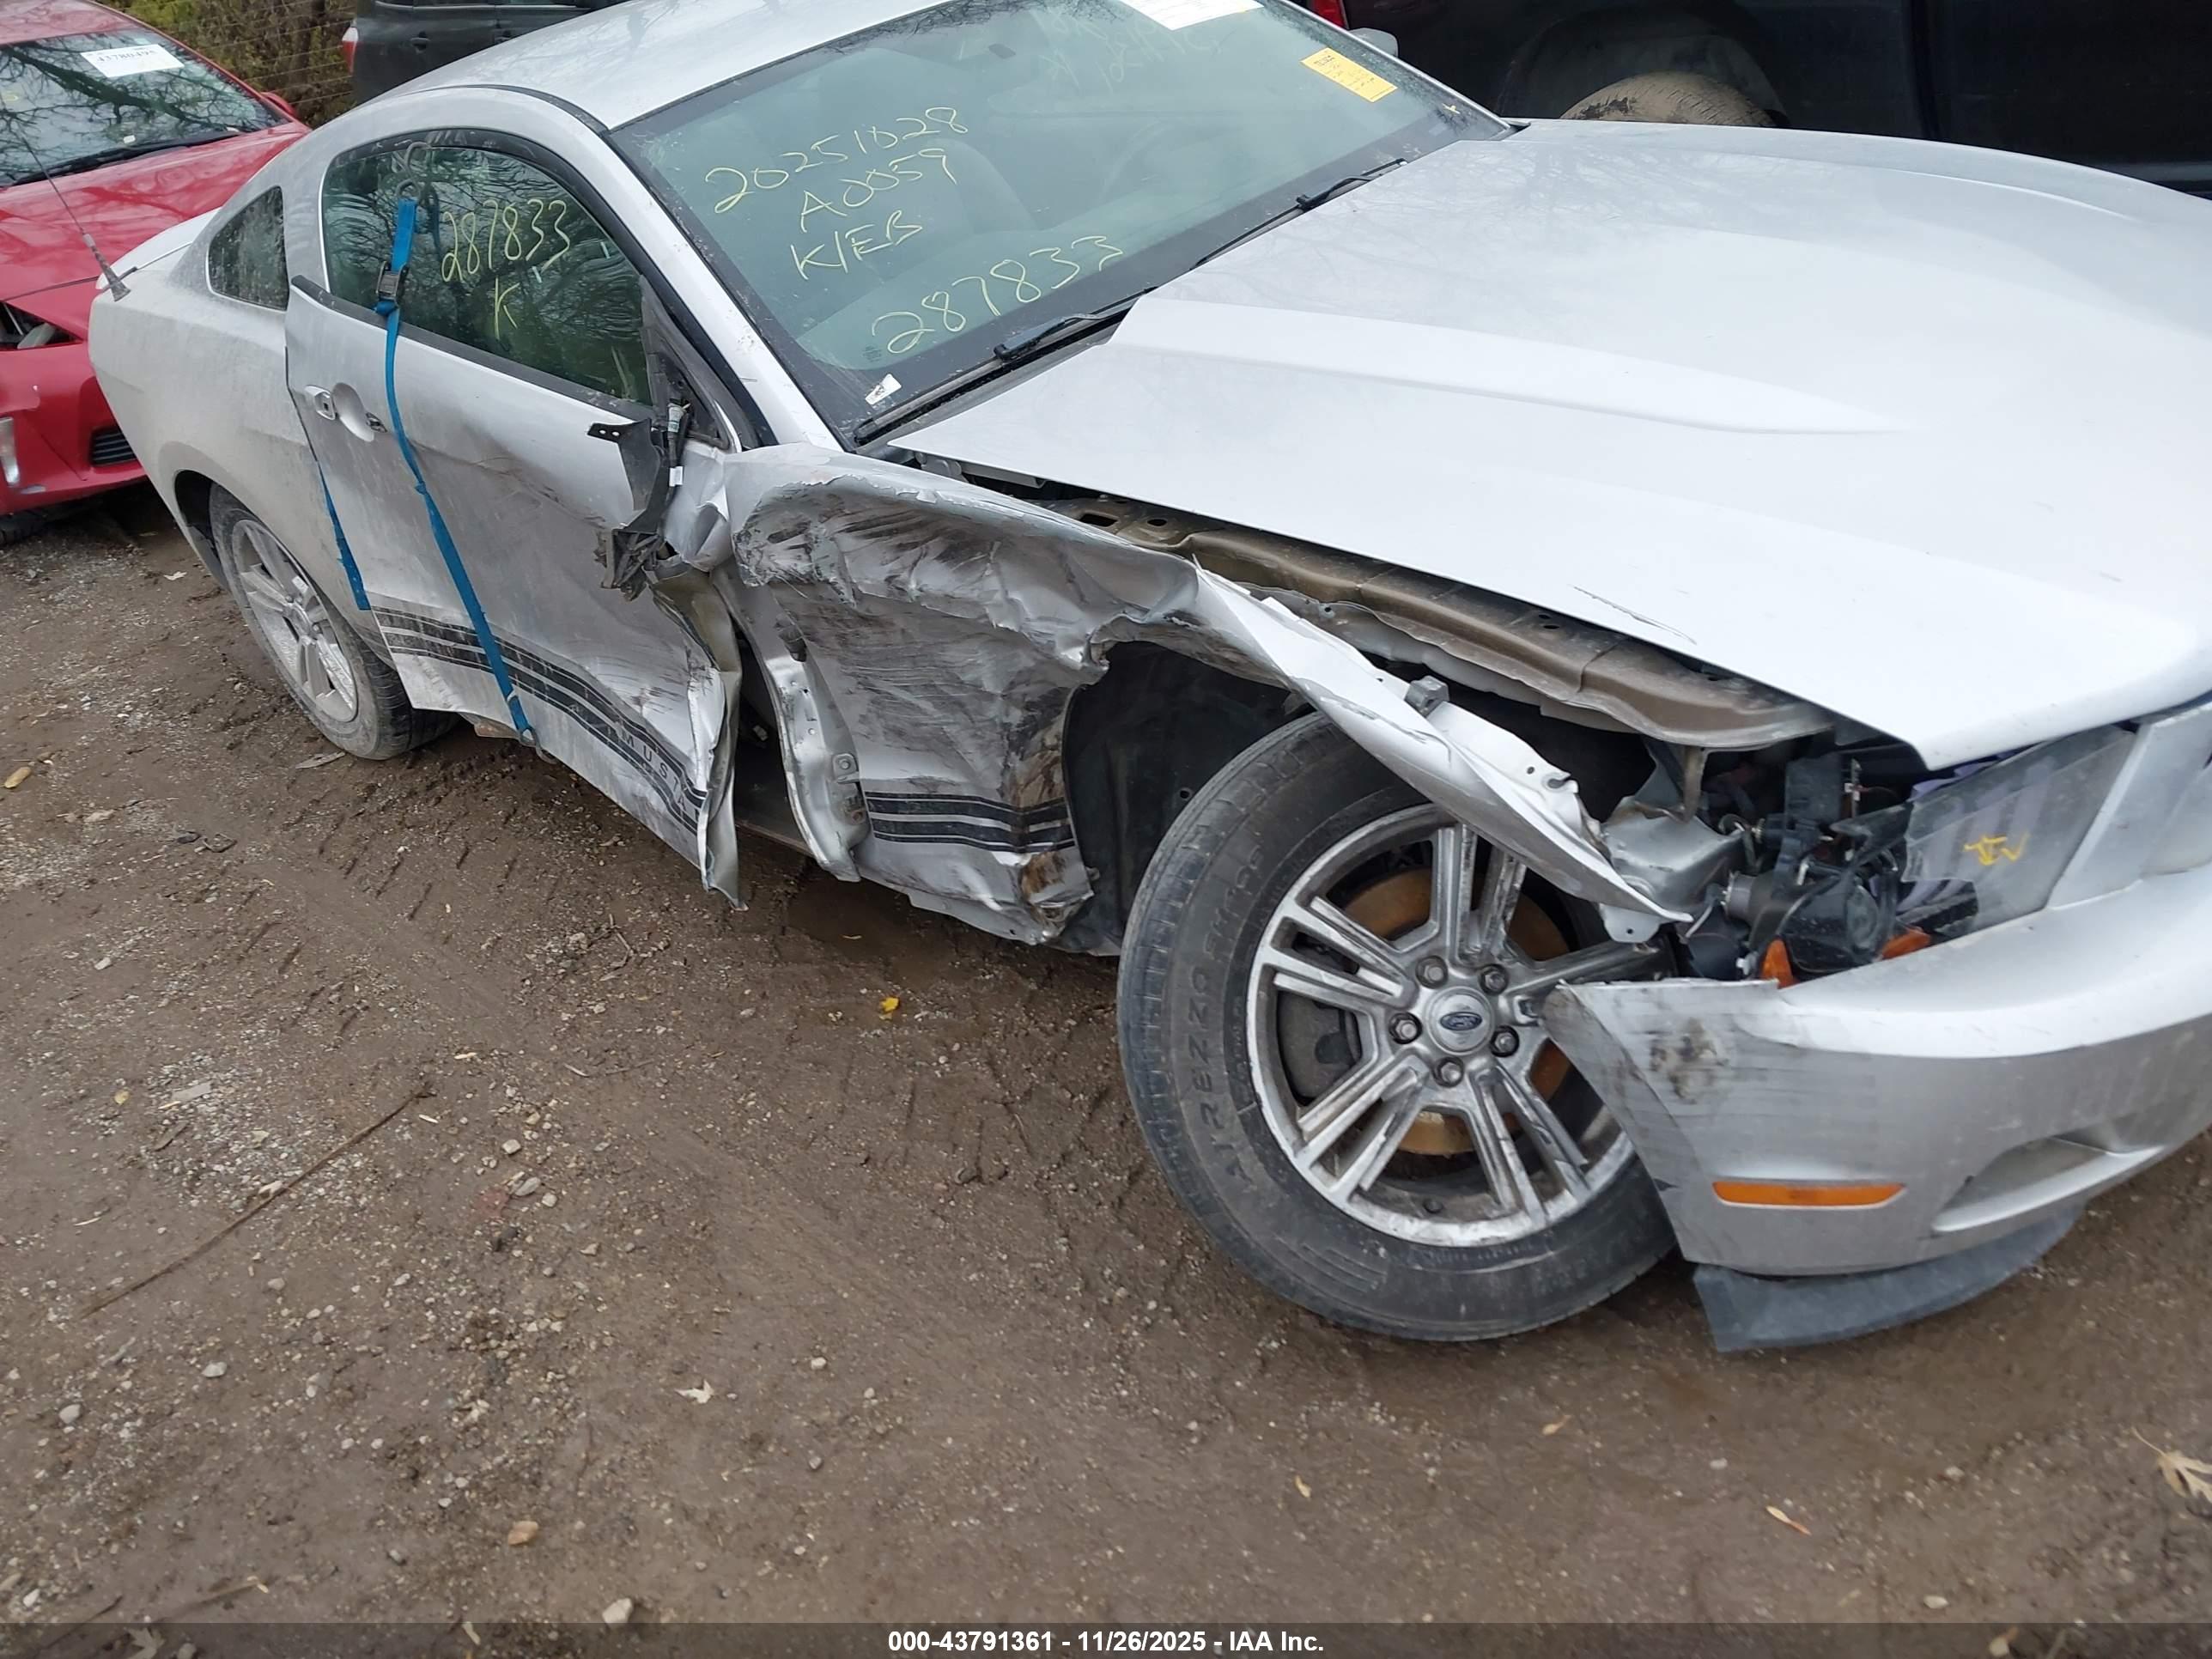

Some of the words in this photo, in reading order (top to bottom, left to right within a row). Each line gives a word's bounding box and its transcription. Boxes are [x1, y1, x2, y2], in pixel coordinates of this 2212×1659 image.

[705, 106, 968, 214] 20251028
[800, 148, 958, 233] A0059
[441, 198, 570, 283] 287833
[495, 276, 520, 340] K
[871, 235, 1124, 355] 287833
